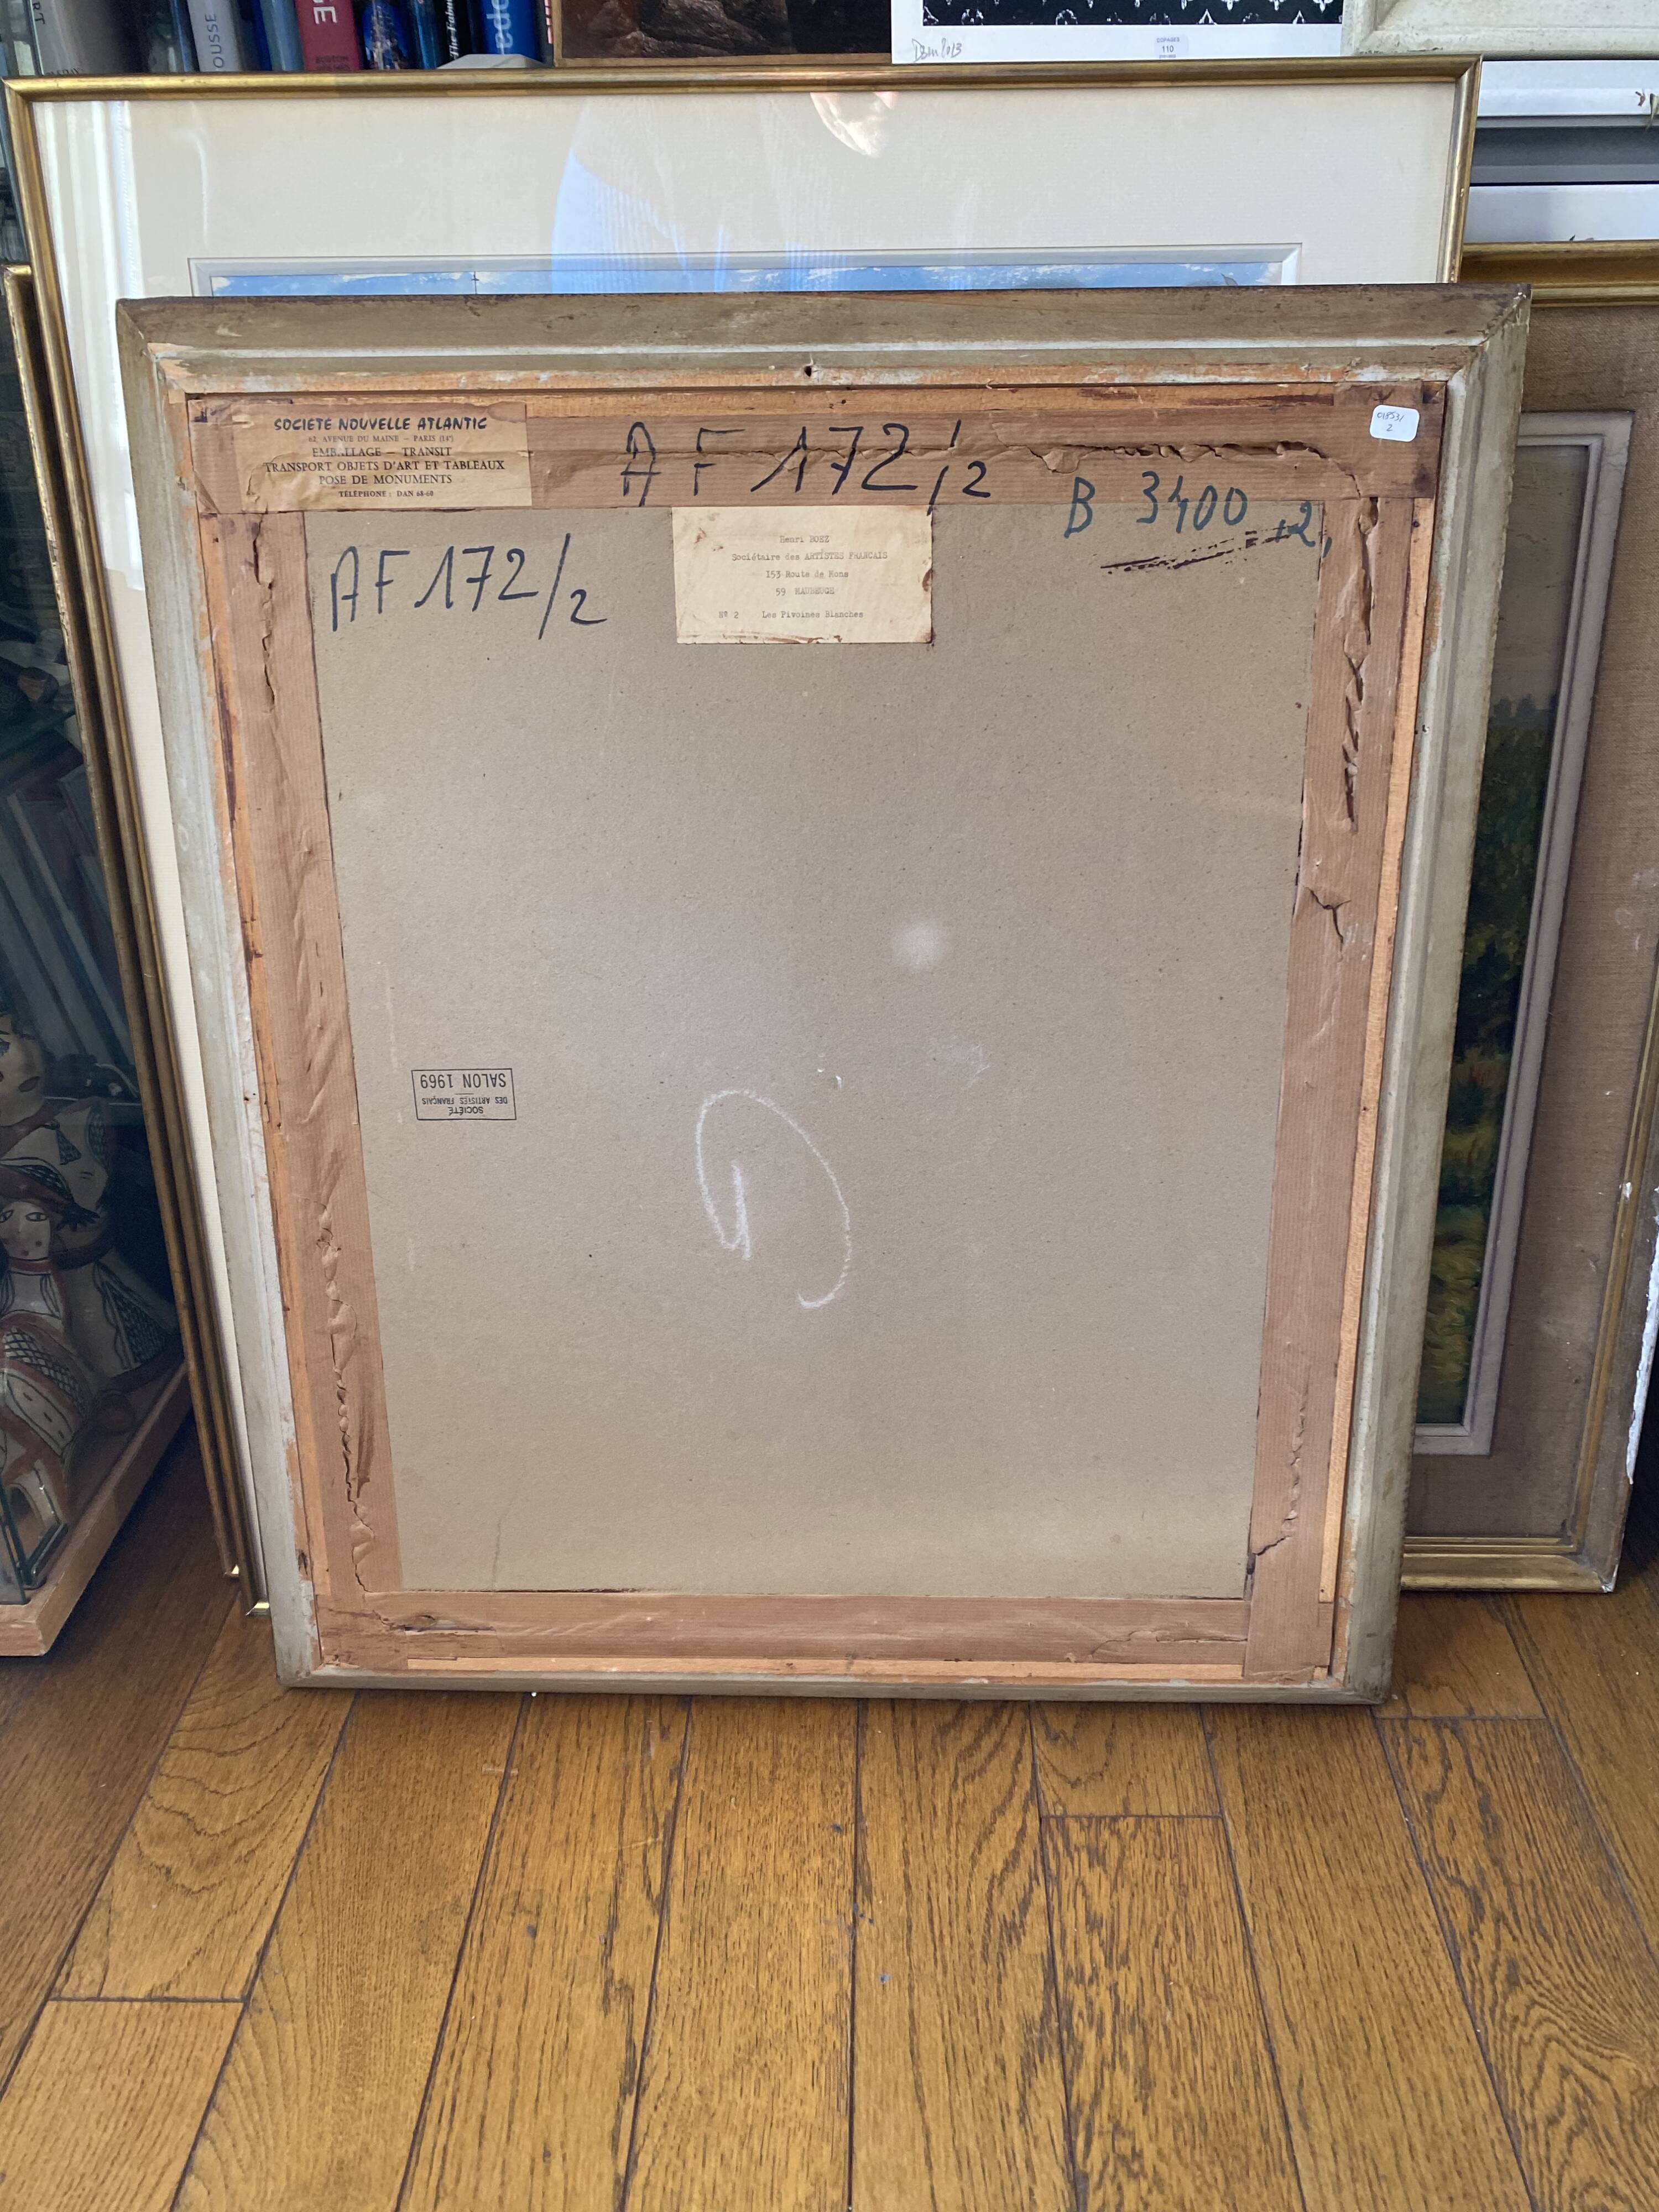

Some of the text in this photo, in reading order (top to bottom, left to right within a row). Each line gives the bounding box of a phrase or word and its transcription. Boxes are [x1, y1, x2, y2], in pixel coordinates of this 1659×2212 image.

[1162, 45, 1174, 53] 110
[338, 416, 410, 430] NOUVELLE
[418, 416, 487, 430] ATLANTIC
[1386, 424, 1393, 432] 2
[401, 447, 452, 457] TRANSIT
[263, 460, 505, 472] TRANSPORT OBJETS D'ART ET TABLEAUX
[319, 474, 452, 485] POSE DE MONUMENTS
[1063, 476, 1095, 539] B
[775, 587, 786, 596] 59
[420, 1073, 506, 1089] SALON 1969
[421, 1096, 454, 1105] FRANÇAIS
[448, 1107, 483, 1116] SOCIÉTÉ
